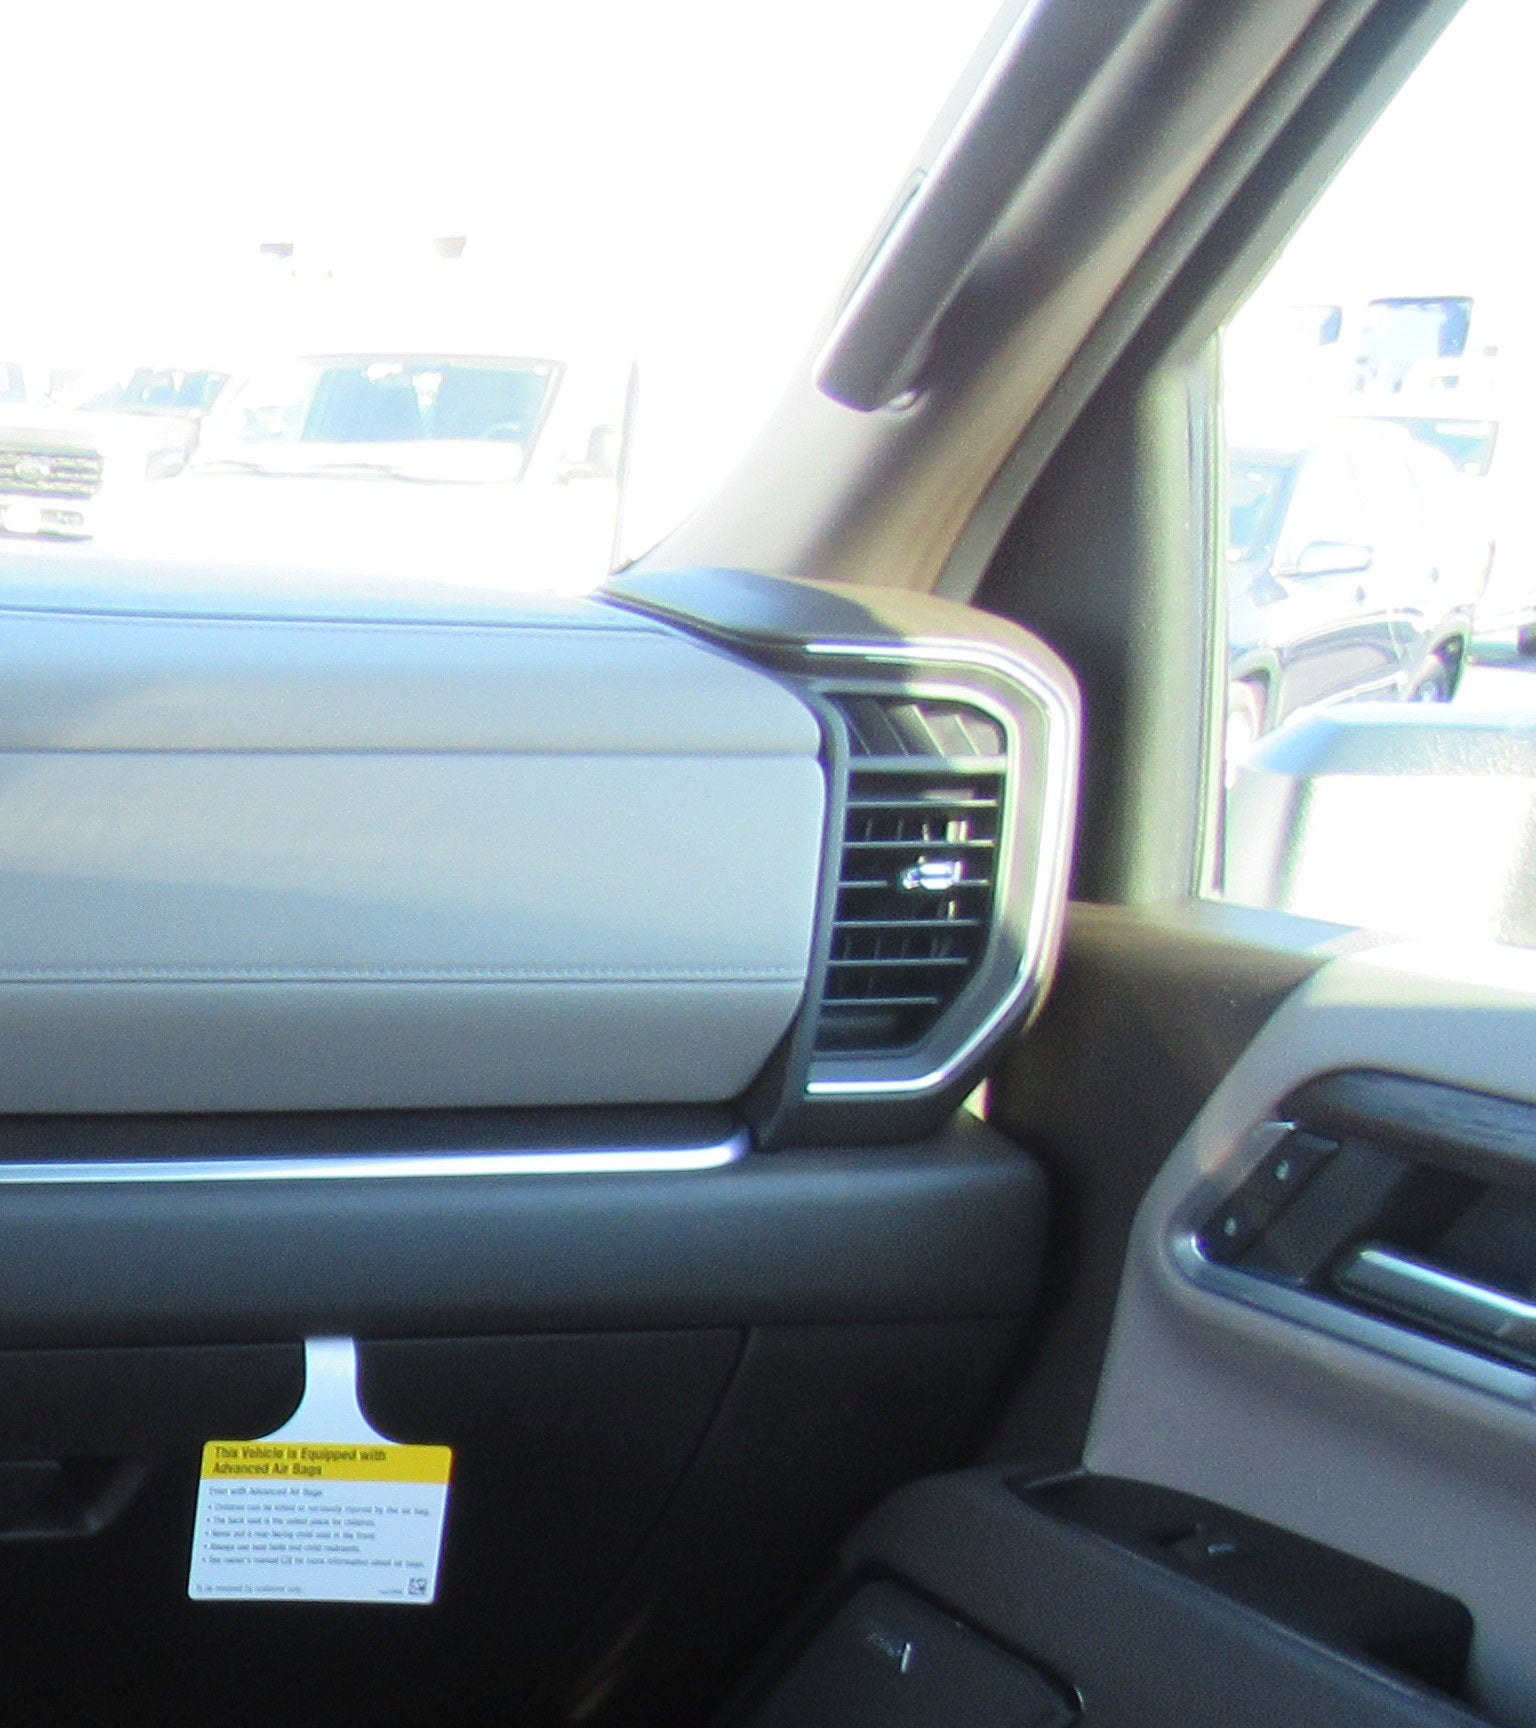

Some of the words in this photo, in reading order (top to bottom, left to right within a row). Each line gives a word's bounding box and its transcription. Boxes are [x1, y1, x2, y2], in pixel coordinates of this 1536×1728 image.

[215, 1446, 238, 1459] This
[241, 1446, 284, 1460] Vehicle
[287, 1448, 298, 1460] is
[300, 1448, 357, 1463] Equipped
[359, 1450, 386, 1462] with
[213, 1461, 270, 1475] Advanced
[271, 1462, 289, 1475] Air
[292, 1462, 323, 1478] Bags
